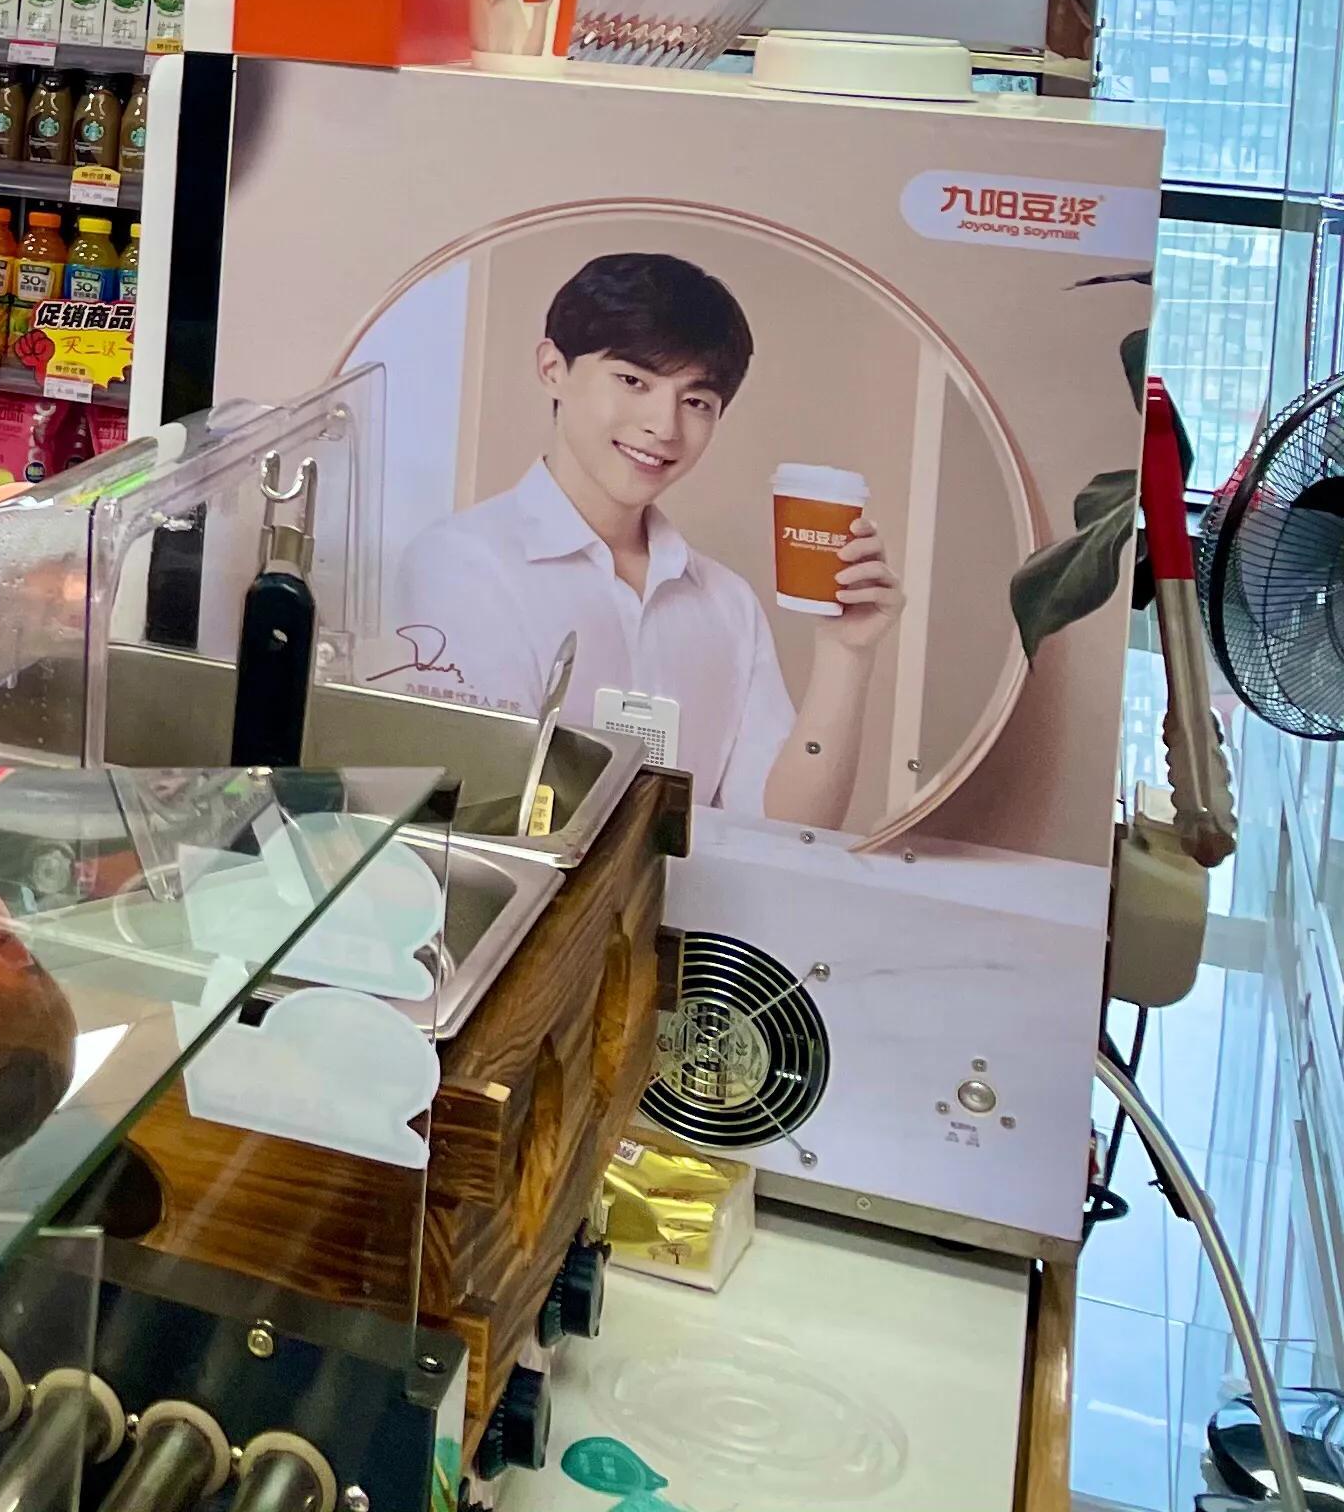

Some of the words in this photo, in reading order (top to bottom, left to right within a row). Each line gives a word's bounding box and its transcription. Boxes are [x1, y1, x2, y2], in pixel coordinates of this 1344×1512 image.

[941, 186, 1098, 226] 九阳豆浆
[957, 220, 1019, 236] Joyoung
[1024, 226, 1080, 240] Soymilk
[37, 302, 135, 330] 促销商品
[61, 335, 133, 357] 买二送一
[782, 527, 847, 546] 九阳豆浆
